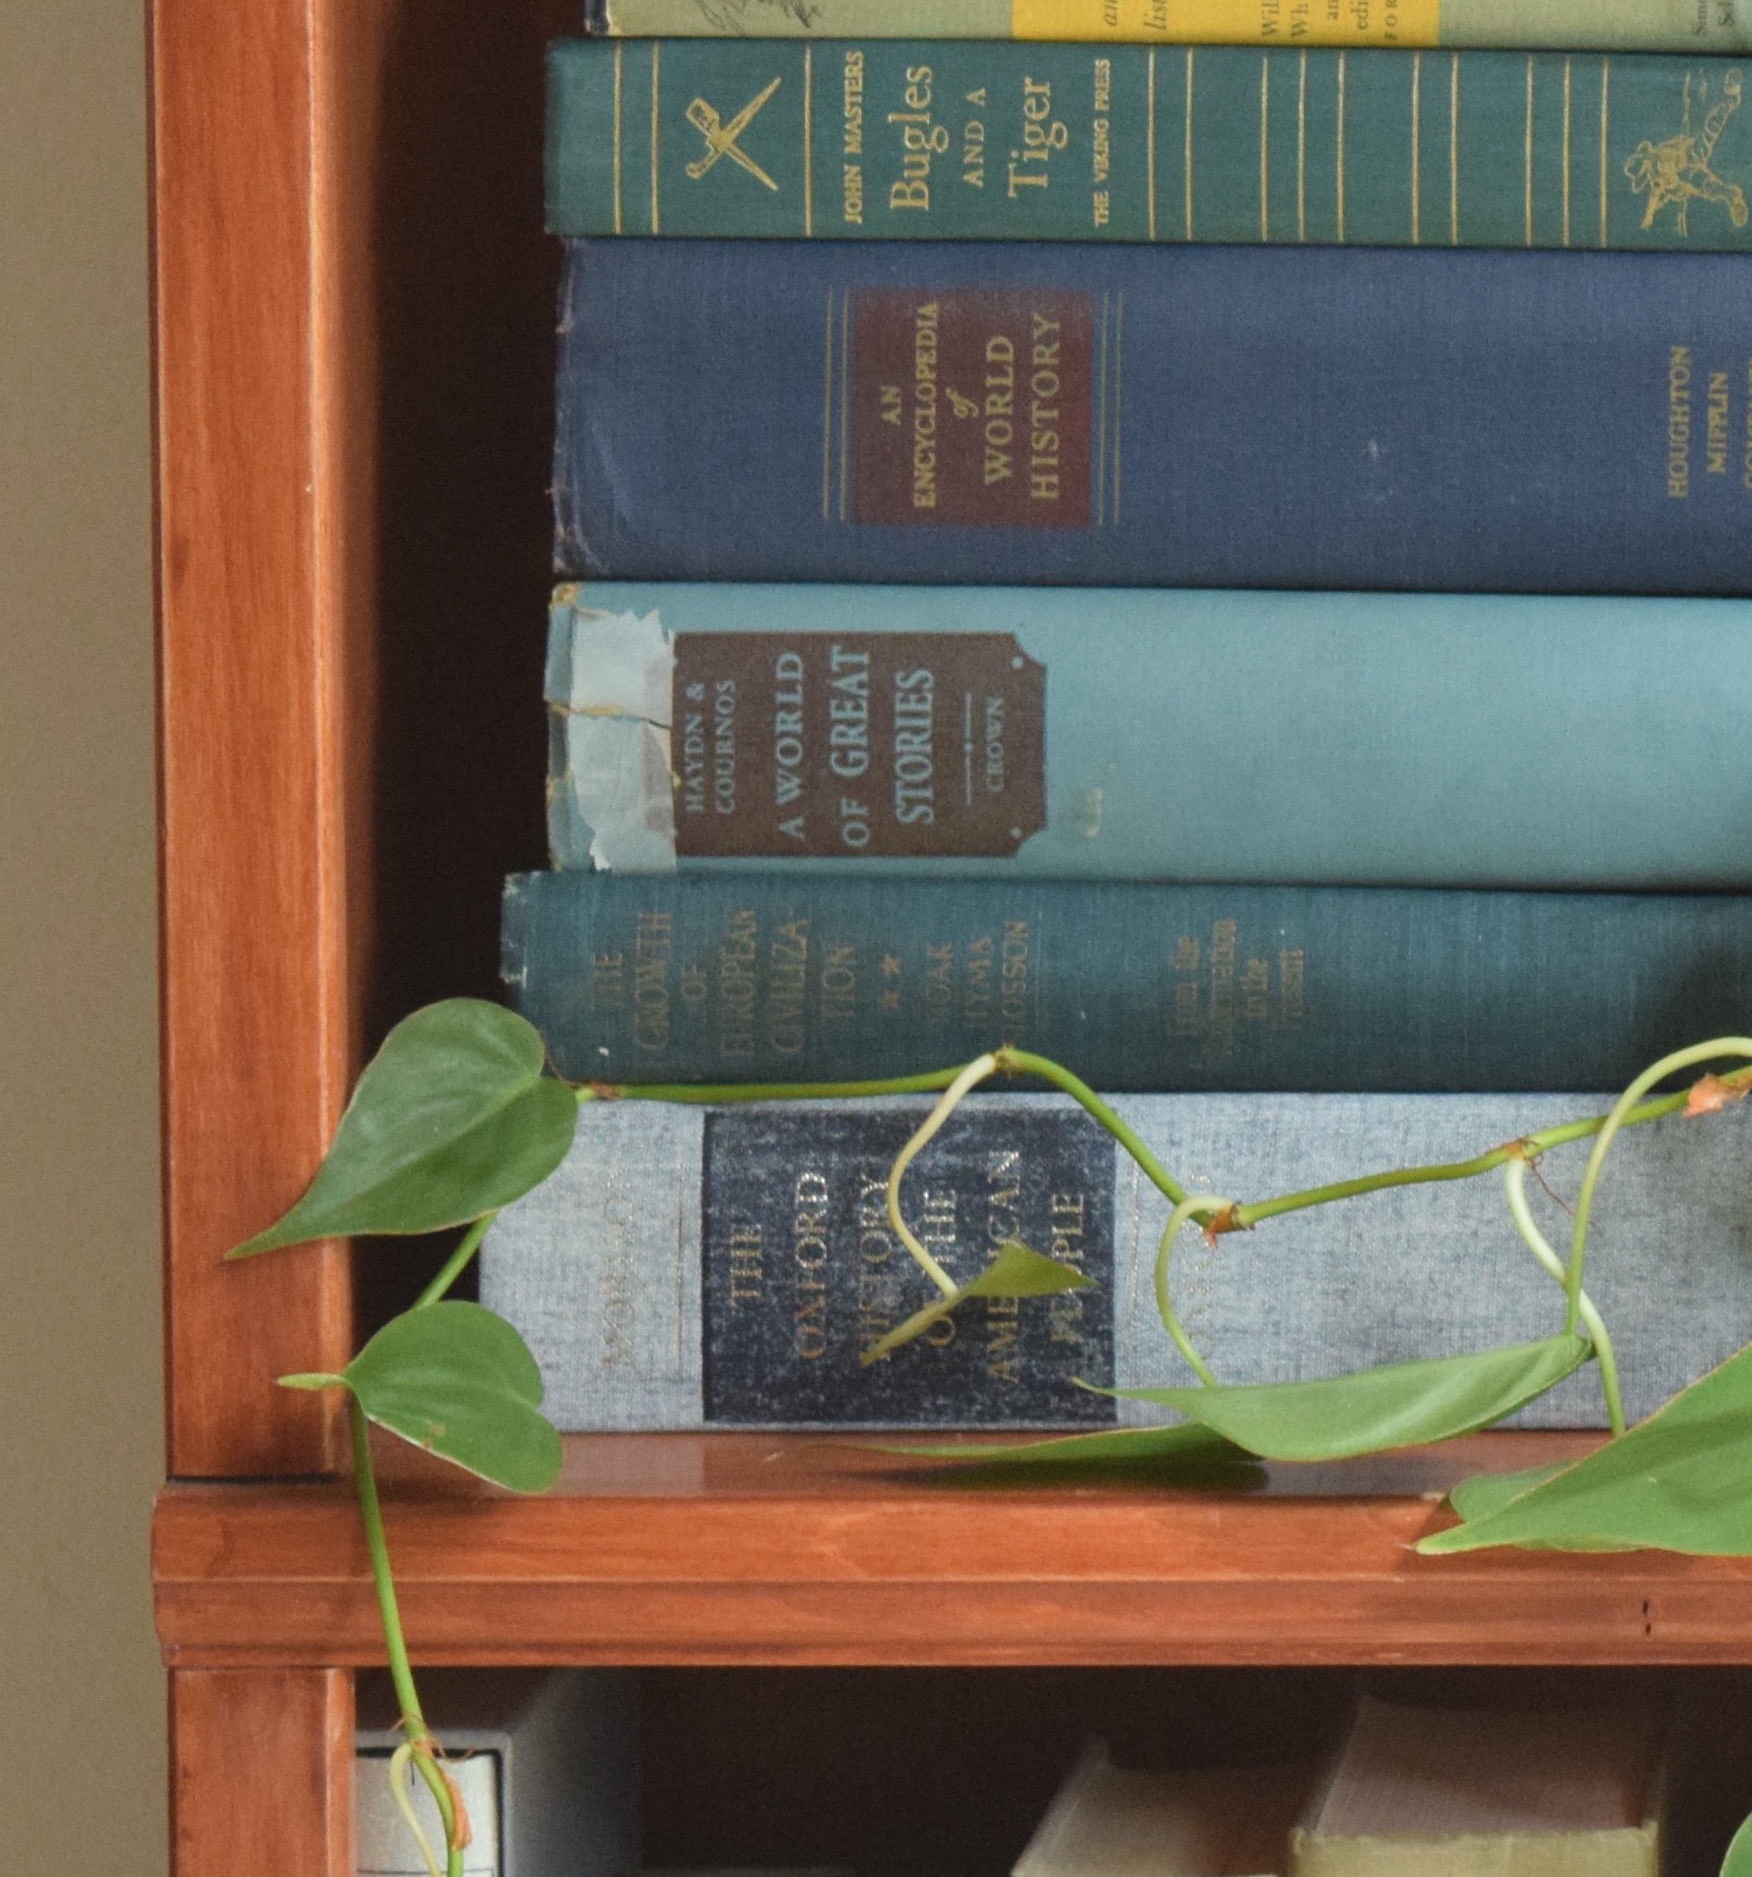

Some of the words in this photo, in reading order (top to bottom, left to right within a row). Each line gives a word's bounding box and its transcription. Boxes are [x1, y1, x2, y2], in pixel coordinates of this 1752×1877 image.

[844, 49, 865, 155] MASTERS
[966, 87, 987, 107] A
[1094, 57, 1111, 112] PRESS
[887, 65, 949, 211] Bugles
[963, 119, 986, 189] AND
[1007, 76, 1069, 199] Tiger
[1093, 117, 1110, 183] VIKING
[844, 163, 864, 224] JOHN
[1093, 189, 1109, 228] THE
[880, 385, 902, 425] AN
[913, 302, 939, 508] ENCYCLOPEDIA
[945, 386, 980, 419] of
[984, 335, 1015, 486] WORLD
[1030, 311, 1062, 500] HISTORY
[1668, 345, 1692, 499] HOUGHTON
[1706, 371, 1730, 474] MIFFLIN
[713, 678, 738, 816] COURNOS
[775, 650, 805, 806] WORLD
[828, 643, 871, 779] GREAT
[893, 667, 936, 826] STORIES
[985, 694, 1006, 794] CROWN
[684, 713, 706, 813] HAYDN
[776, 816, 805, 840] A
[839, 796, 870, 848] OF
[633, 911, 673, 1052] GROWTH
[680, 964, 708, 1003] OF
[729, 1222, 763, 1309] THE
[793, 1171, 829, 1360] OXFORD
[987, 1150, 1020, 1385] AMEICAN
